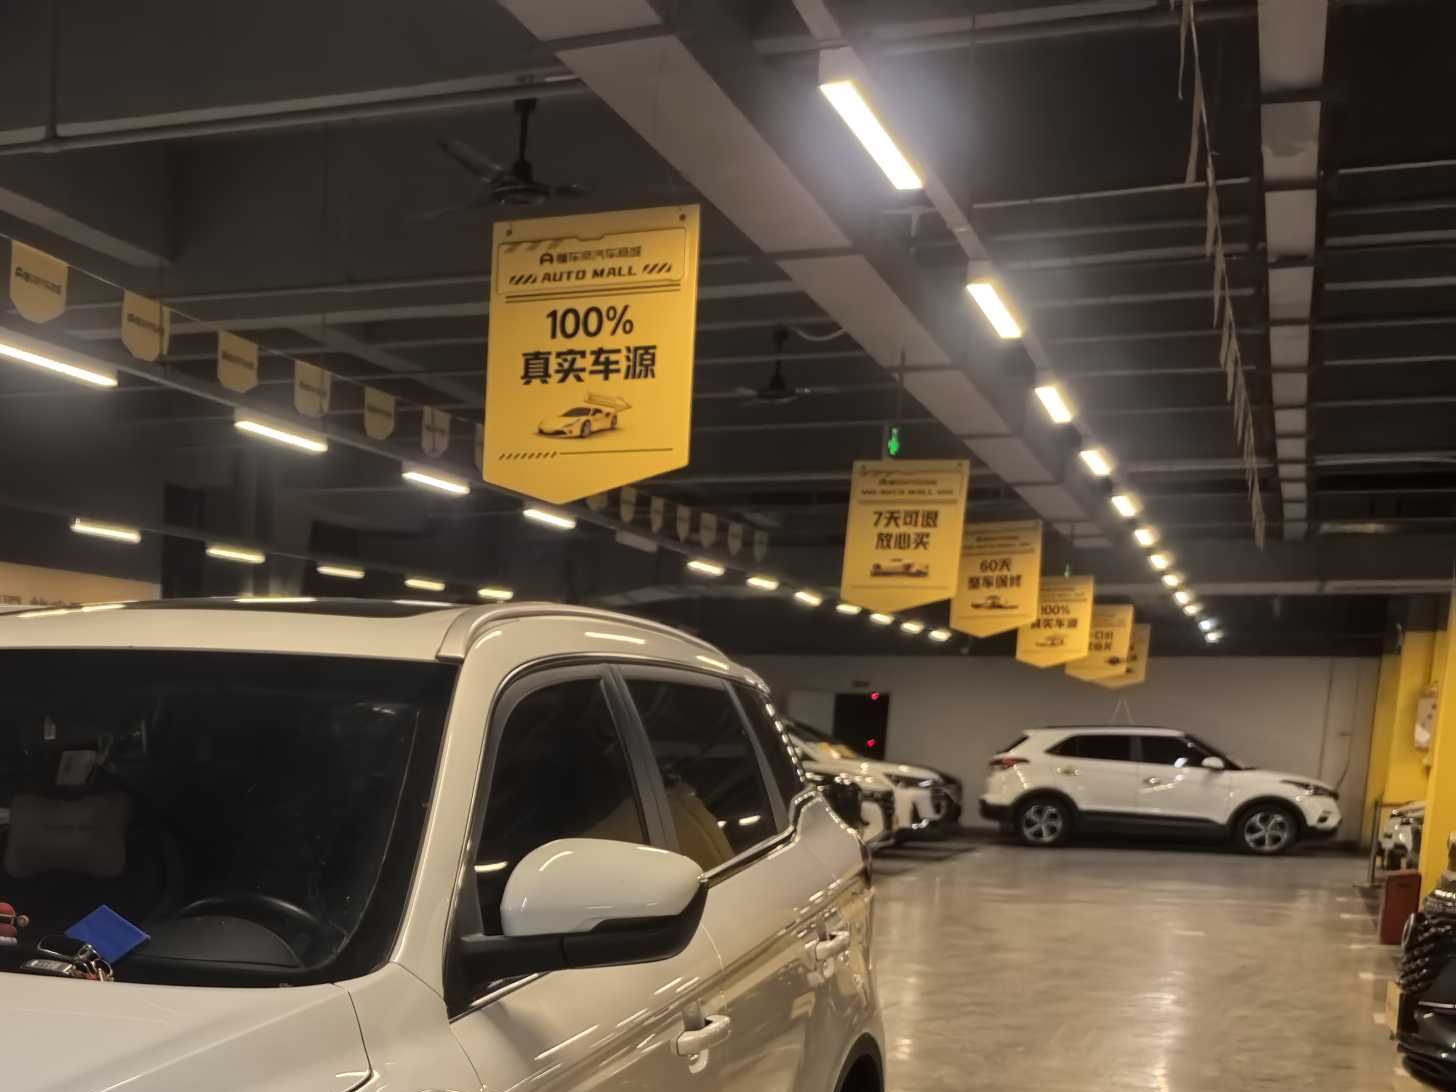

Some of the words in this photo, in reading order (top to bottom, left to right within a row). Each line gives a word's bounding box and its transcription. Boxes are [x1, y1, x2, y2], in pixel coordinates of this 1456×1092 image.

[541, 269, 586, 283] AUTO
[592, 266, 638, 279] MALL
[546, 304, 634, 340] 100%
[520, 345, 658, 386] 真实车源
